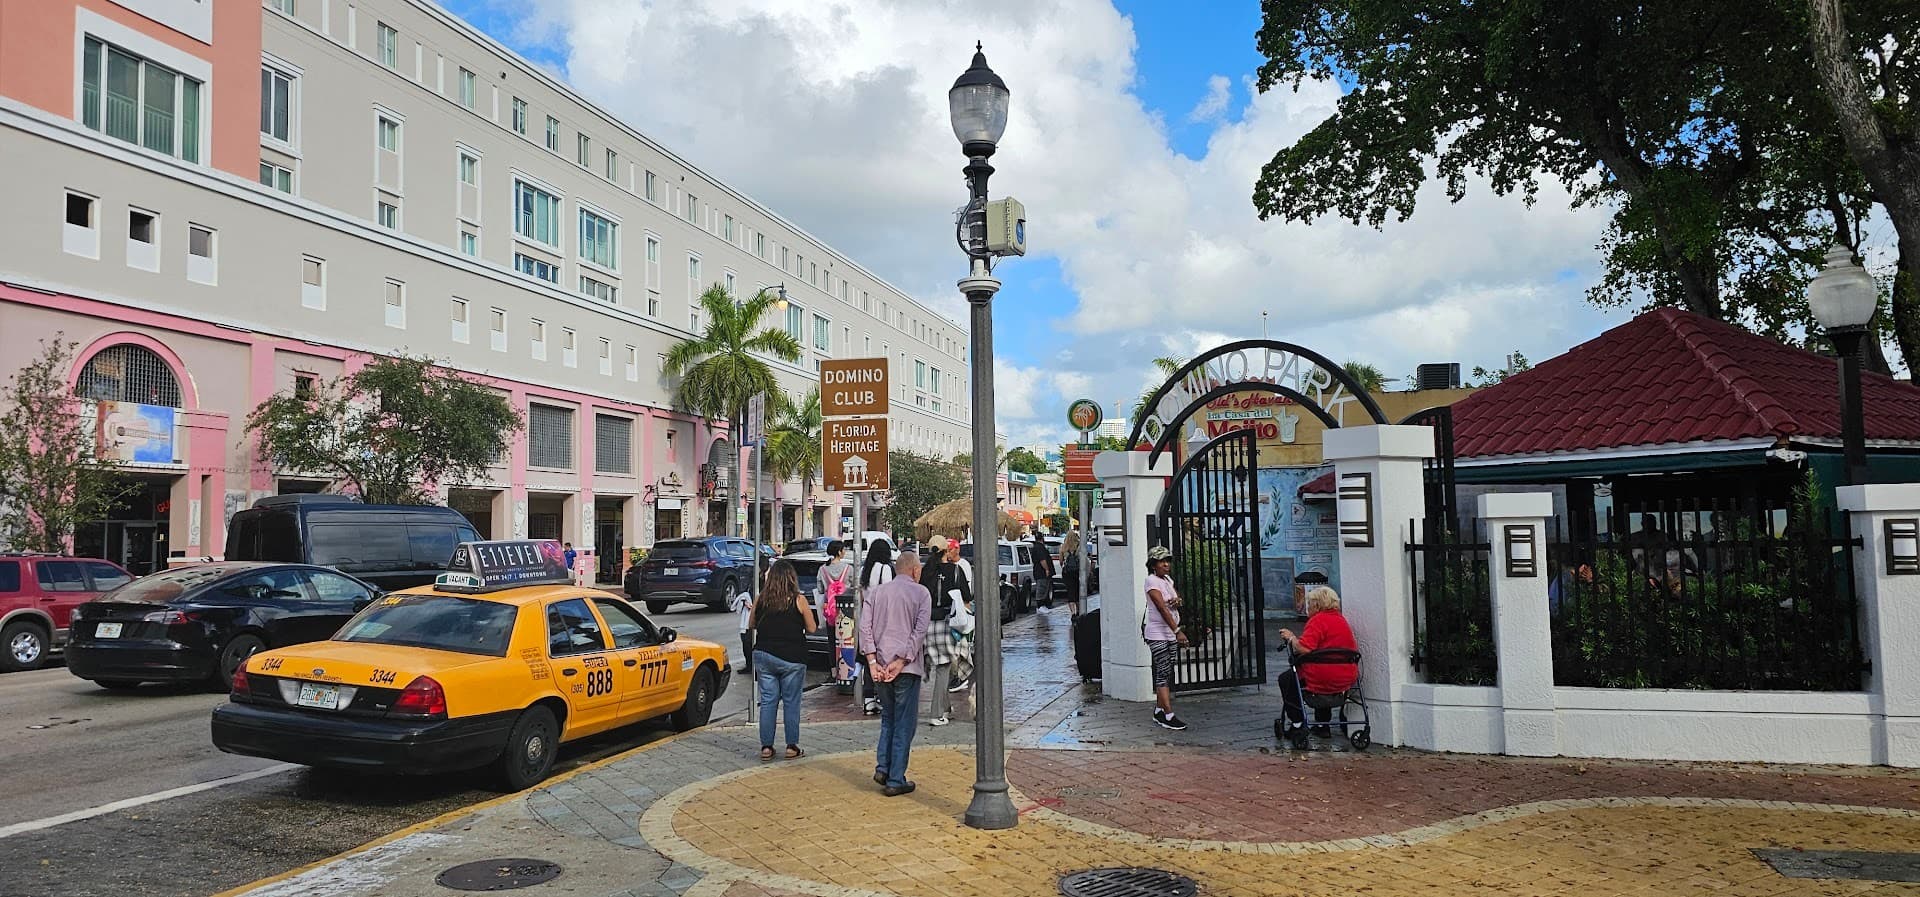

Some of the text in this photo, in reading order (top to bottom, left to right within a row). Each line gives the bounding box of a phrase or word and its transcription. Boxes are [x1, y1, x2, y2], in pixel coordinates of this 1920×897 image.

[825, 368, 883, 384] DOMINO
[834, 391, 875, 406] CLUB
[1140, 347, 1358, 447] DOMINO PARK
[1240, 392, 1298, 409] Havan
[1224, 410, 1250, 418] Casa
[1254, 408, 1271, 417] del
[832, 423, 877, 438] FLORIDA
[830, 440, 880, 454] HERITAGE
[477, 544, 544, 568] E11EVEN
[485, 574, 500, 582] OPEN
[519, 571, 547, 579] DOWNTOWN
[583, 657, 609, 669] SUPER
[261, 658, 397, 685] 3344 3344
[640, 660, 668, 688] 7777
[571, 668, 613, 698] (305) 888
